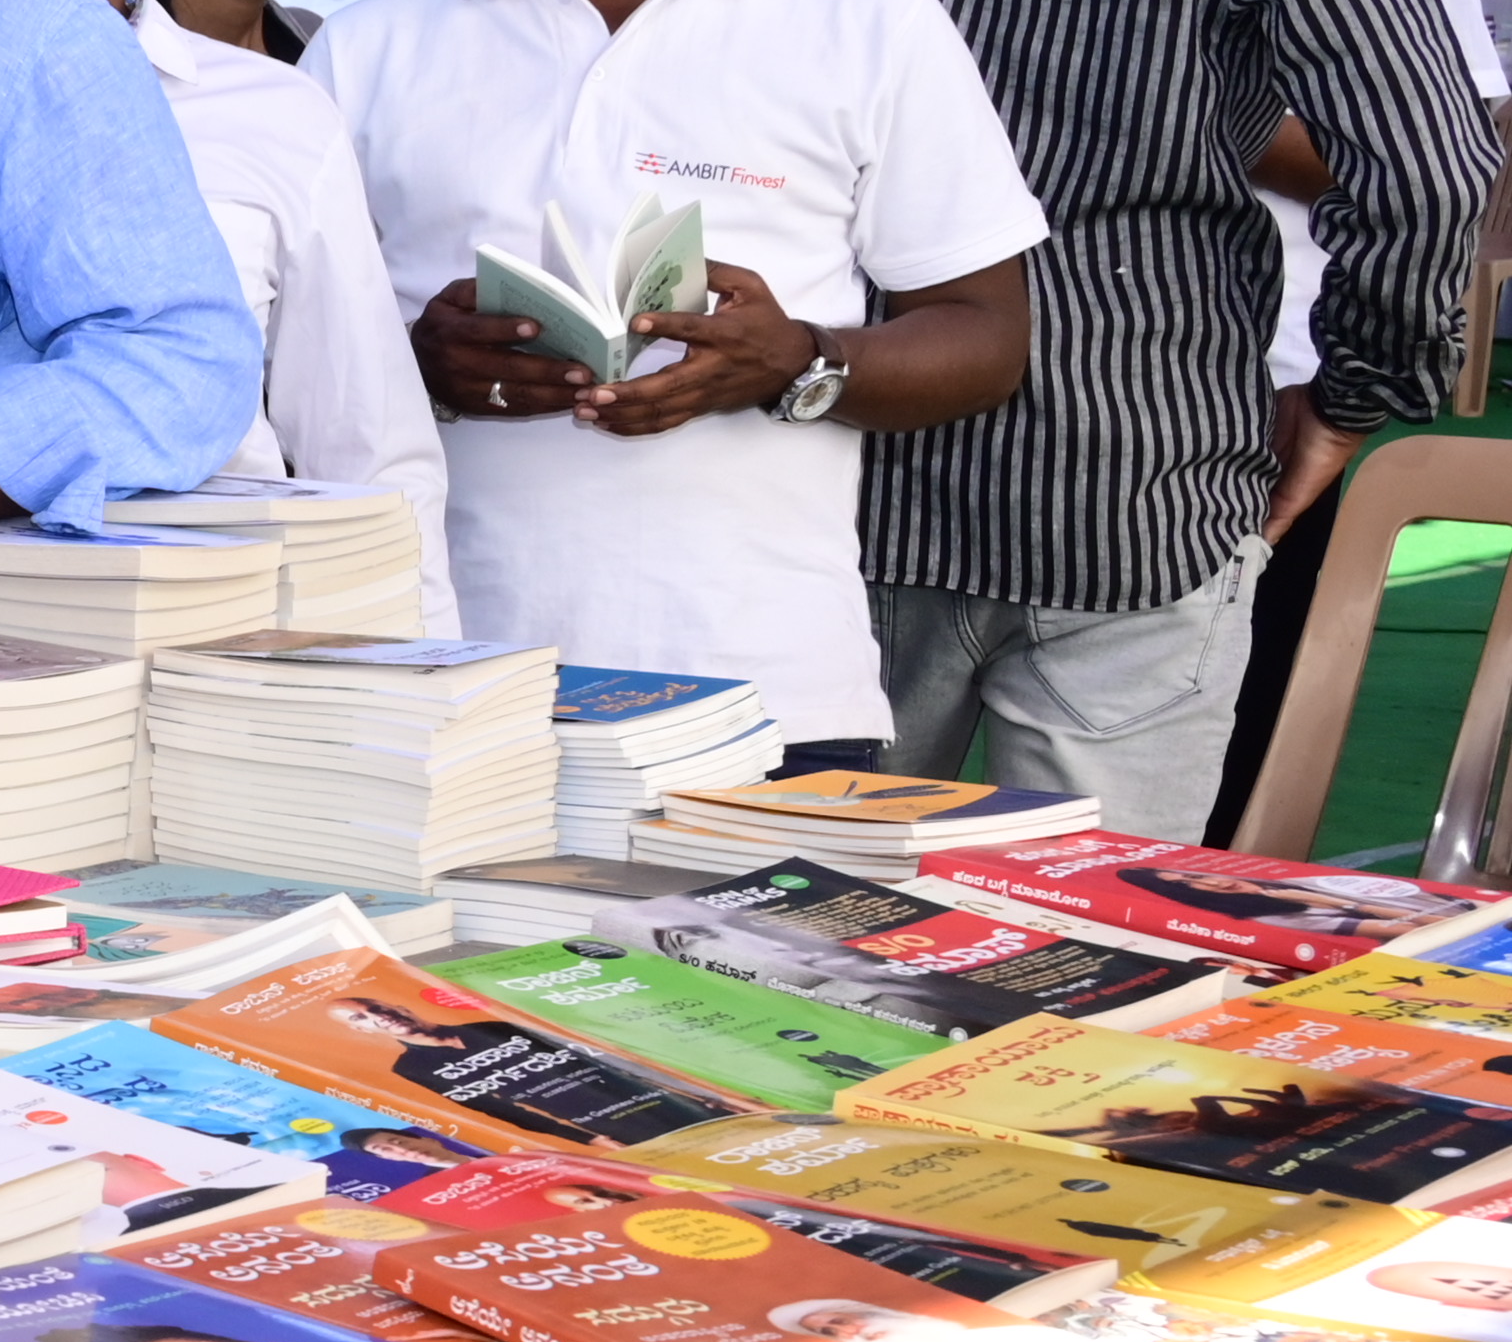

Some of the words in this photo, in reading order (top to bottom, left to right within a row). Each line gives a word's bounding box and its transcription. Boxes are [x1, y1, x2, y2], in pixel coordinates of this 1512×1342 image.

[667, 159, 730, 184] AMBIT
[730, 167, 786, 190] Finvest
[694, 890, 736, 908] SON
[708, 885, 789, 911] HAMAS
[951, 870, 987, 888] ಹಣದ
[987, 878, 1009, 898] ಬಗ್ಗೆ
[1010, 884, 1092, 911] ಮಾತಾಡೋಣ
[860, 930, 937, 958] S/O
[883, 927, 1029, 979] ಹಮಾಸ್
[495, 960, 603, 993] ರಾಬಿನ್
[676, 950, 704, 969] S/O
[705, 960, 758, 985] ಹಮಾಸ್
[219, 982, 285, 1017] ರಾಬಿನ್
[289, 961, 353, 991] ಶರ್ಮಾ
[537, 975, 652, 1008] ಶರ್ಮಾ
[883, 1024, 1087, 1104] ಪ್ರಾಣಾಯಾಮ
[704, 1124, 825, 1167] ರಾಬಿನ್
